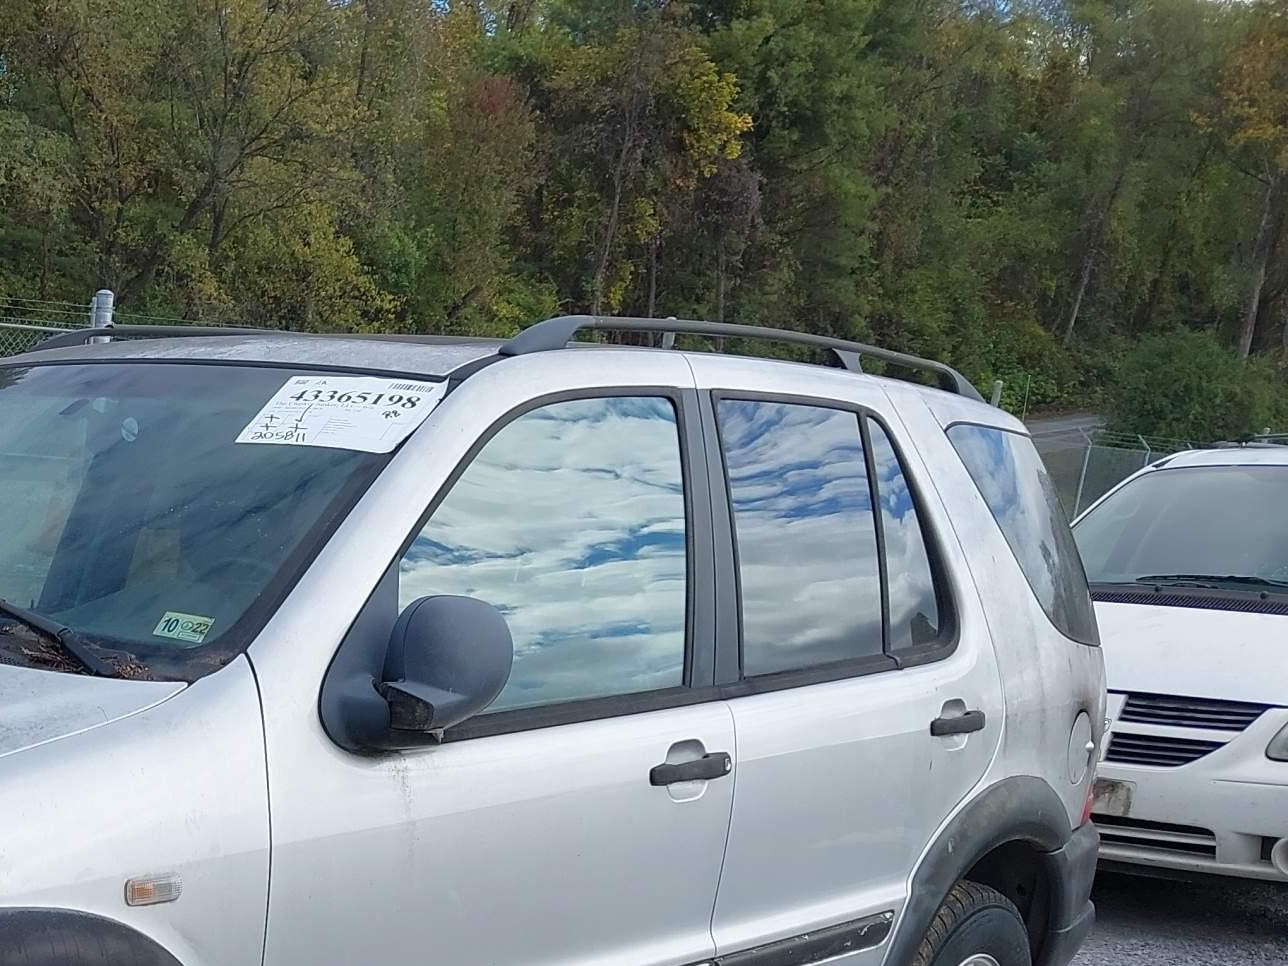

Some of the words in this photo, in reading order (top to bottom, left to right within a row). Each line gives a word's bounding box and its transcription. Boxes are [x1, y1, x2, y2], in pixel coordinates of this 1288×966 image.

[289, 389, 421, 409] 43365198
[162, 617, 179, 632] 10
[191, 622, 209, 634] 22
